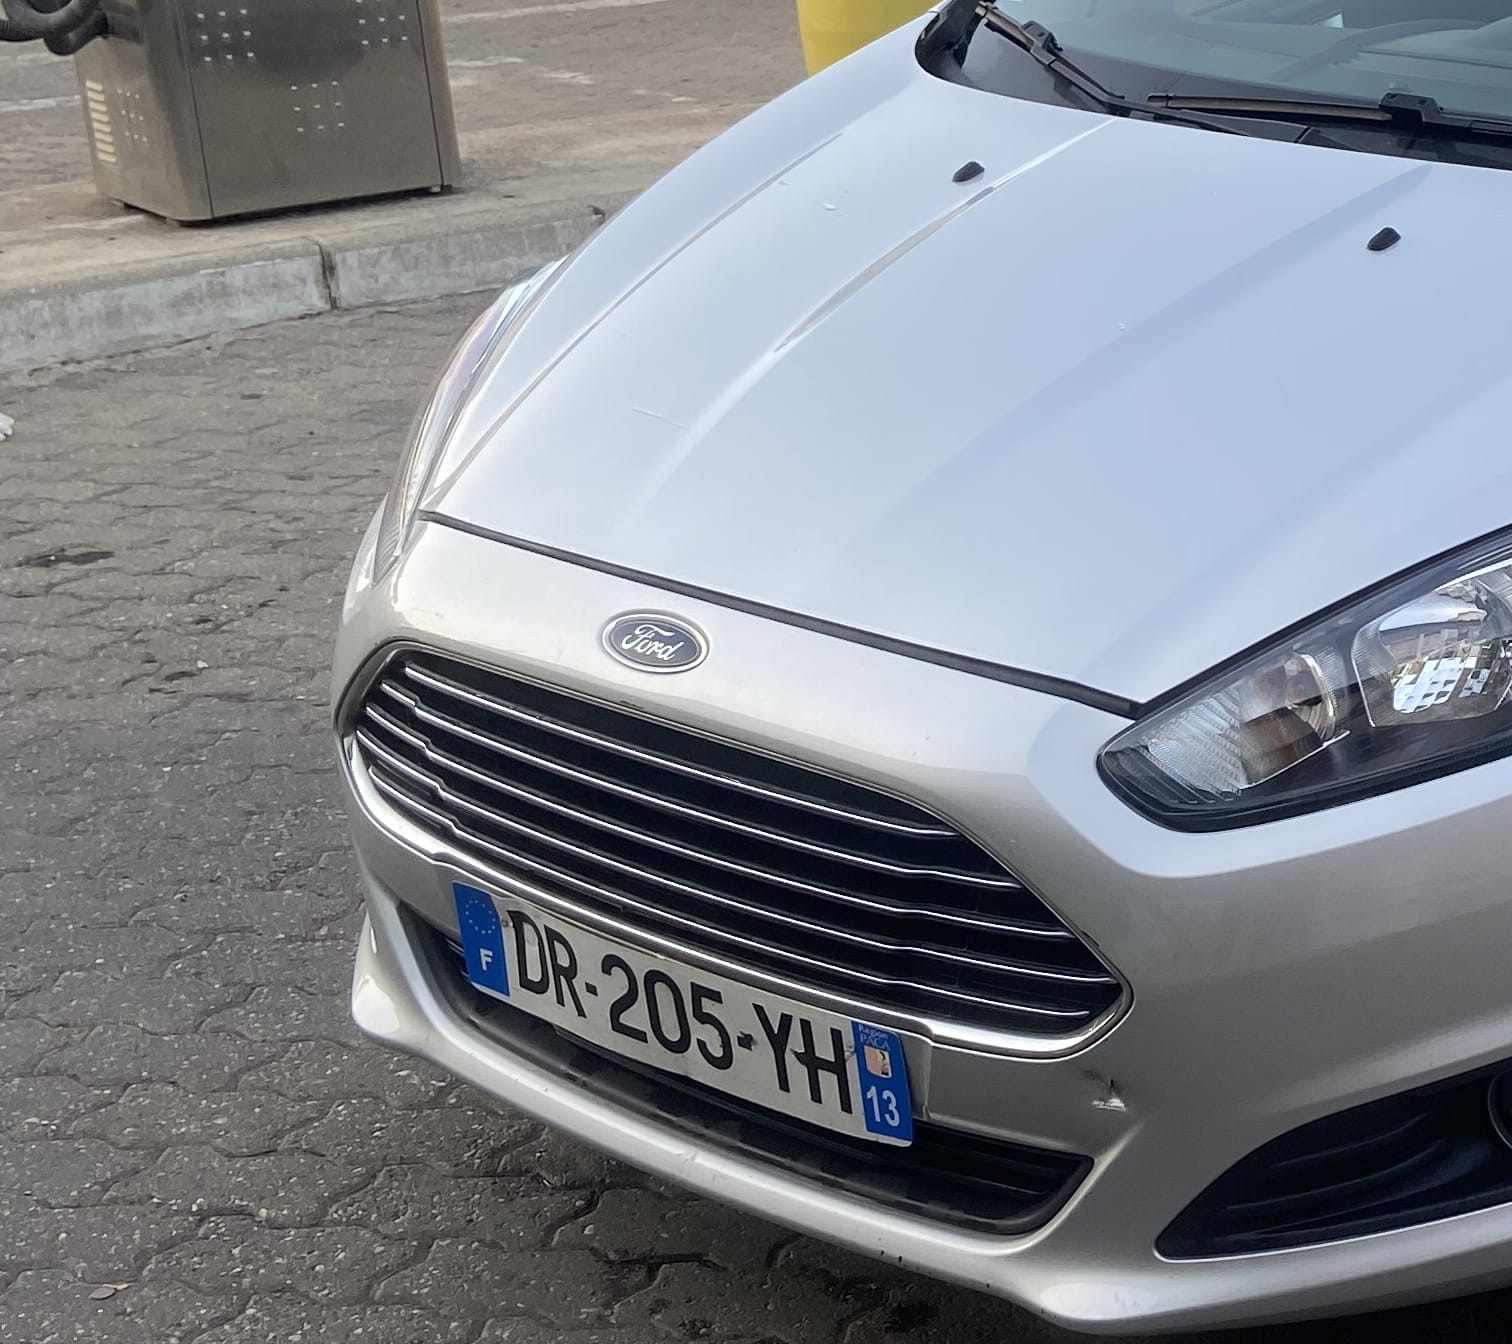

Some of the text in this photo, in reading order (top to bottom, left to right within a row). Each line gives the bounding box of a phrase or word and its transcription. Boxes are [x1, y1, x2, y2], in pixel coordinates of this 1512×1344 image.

[621, 624, 685, 661] Ford
[480, 948, 493, 972] F
[506, 909, 853, 1115] DR-205-YH
[859, 1033, 891, 1052] PACA
[866, 1084, 901, 1128] 13
